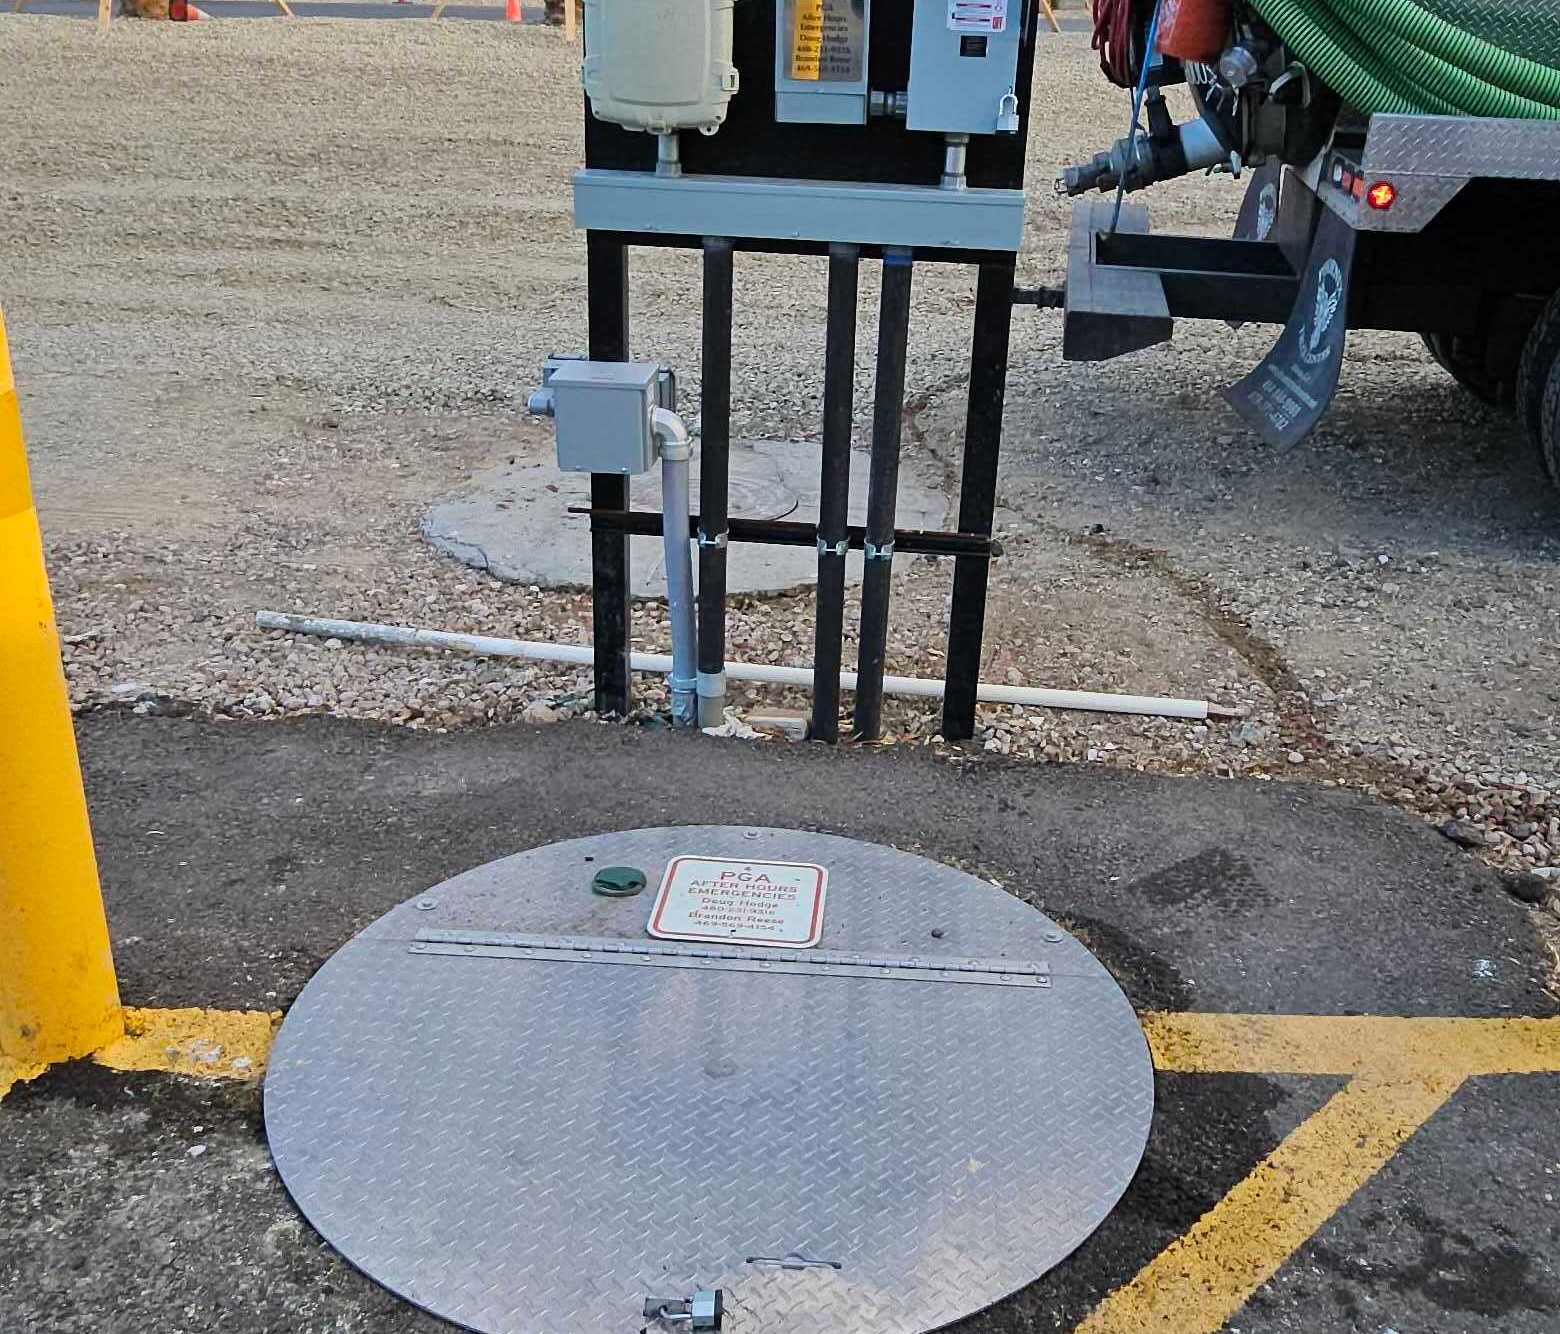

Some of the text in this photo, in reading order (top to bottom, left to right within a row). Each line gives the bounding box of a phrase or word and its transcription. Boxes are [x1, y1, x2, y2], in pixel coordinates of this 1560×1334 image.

[720, 871, 772, 884] PGA
[690, 880, 798, 893] AFTER HOURS
[688, 887, 797, 900] EMERGENCIES
[702, 898, 779, 908] Doug Hodge
[688, 910, 784, 924] Brandon Reese
